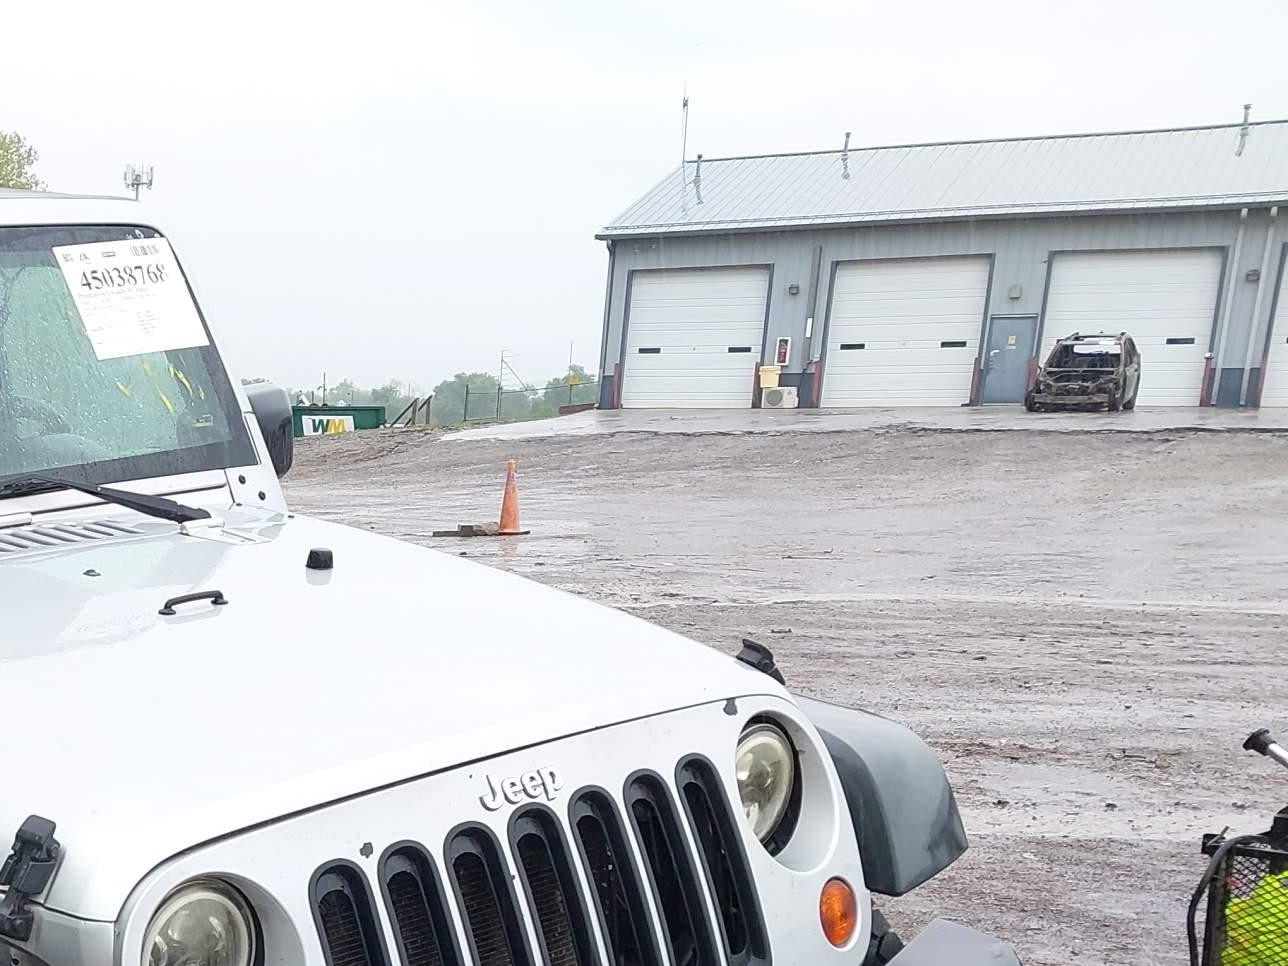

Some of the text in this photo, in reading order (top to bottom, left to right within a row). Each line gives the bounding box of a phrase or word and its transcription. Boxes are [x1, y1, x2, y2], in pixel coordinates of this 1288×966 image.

[80, 263, 169, 290] 45038768
[312, 418, 345, 434] WM
[478, 767, 564, 812] Jeep
